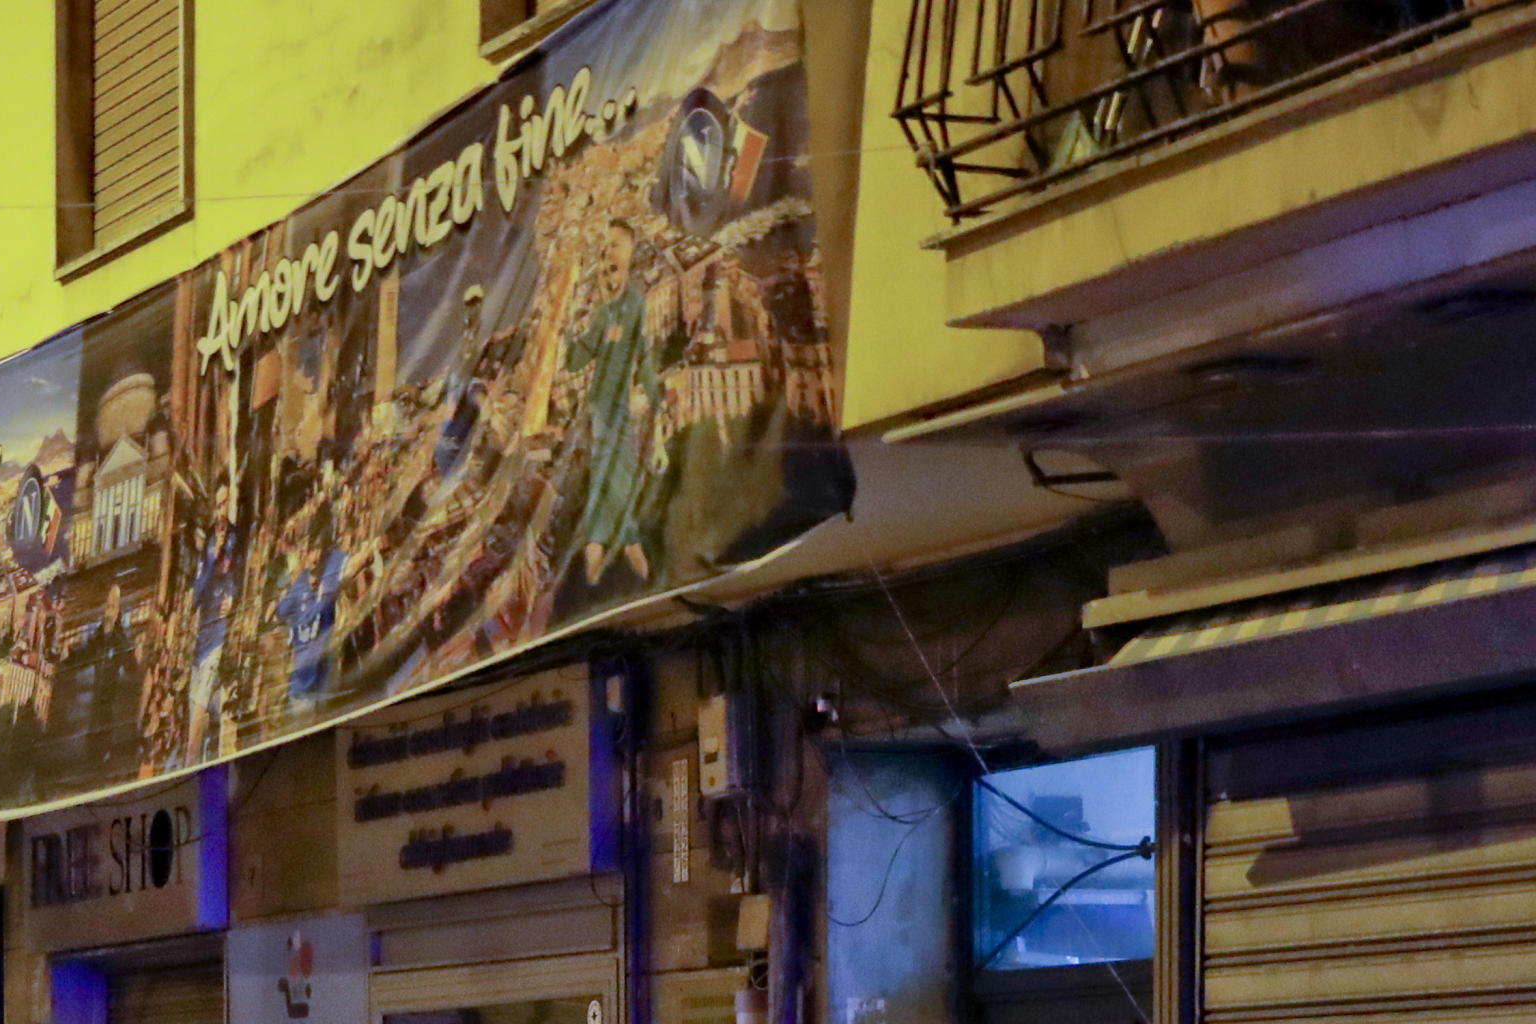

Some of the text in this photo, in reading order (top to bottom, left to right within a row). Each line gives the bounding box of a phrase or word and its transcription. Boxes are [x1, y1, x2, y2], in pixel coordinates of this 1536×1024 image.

[197, 230, 340, 376] Amore
[347, 143, 484, 294] senza
[108, 804, 192, 896] SHOP
